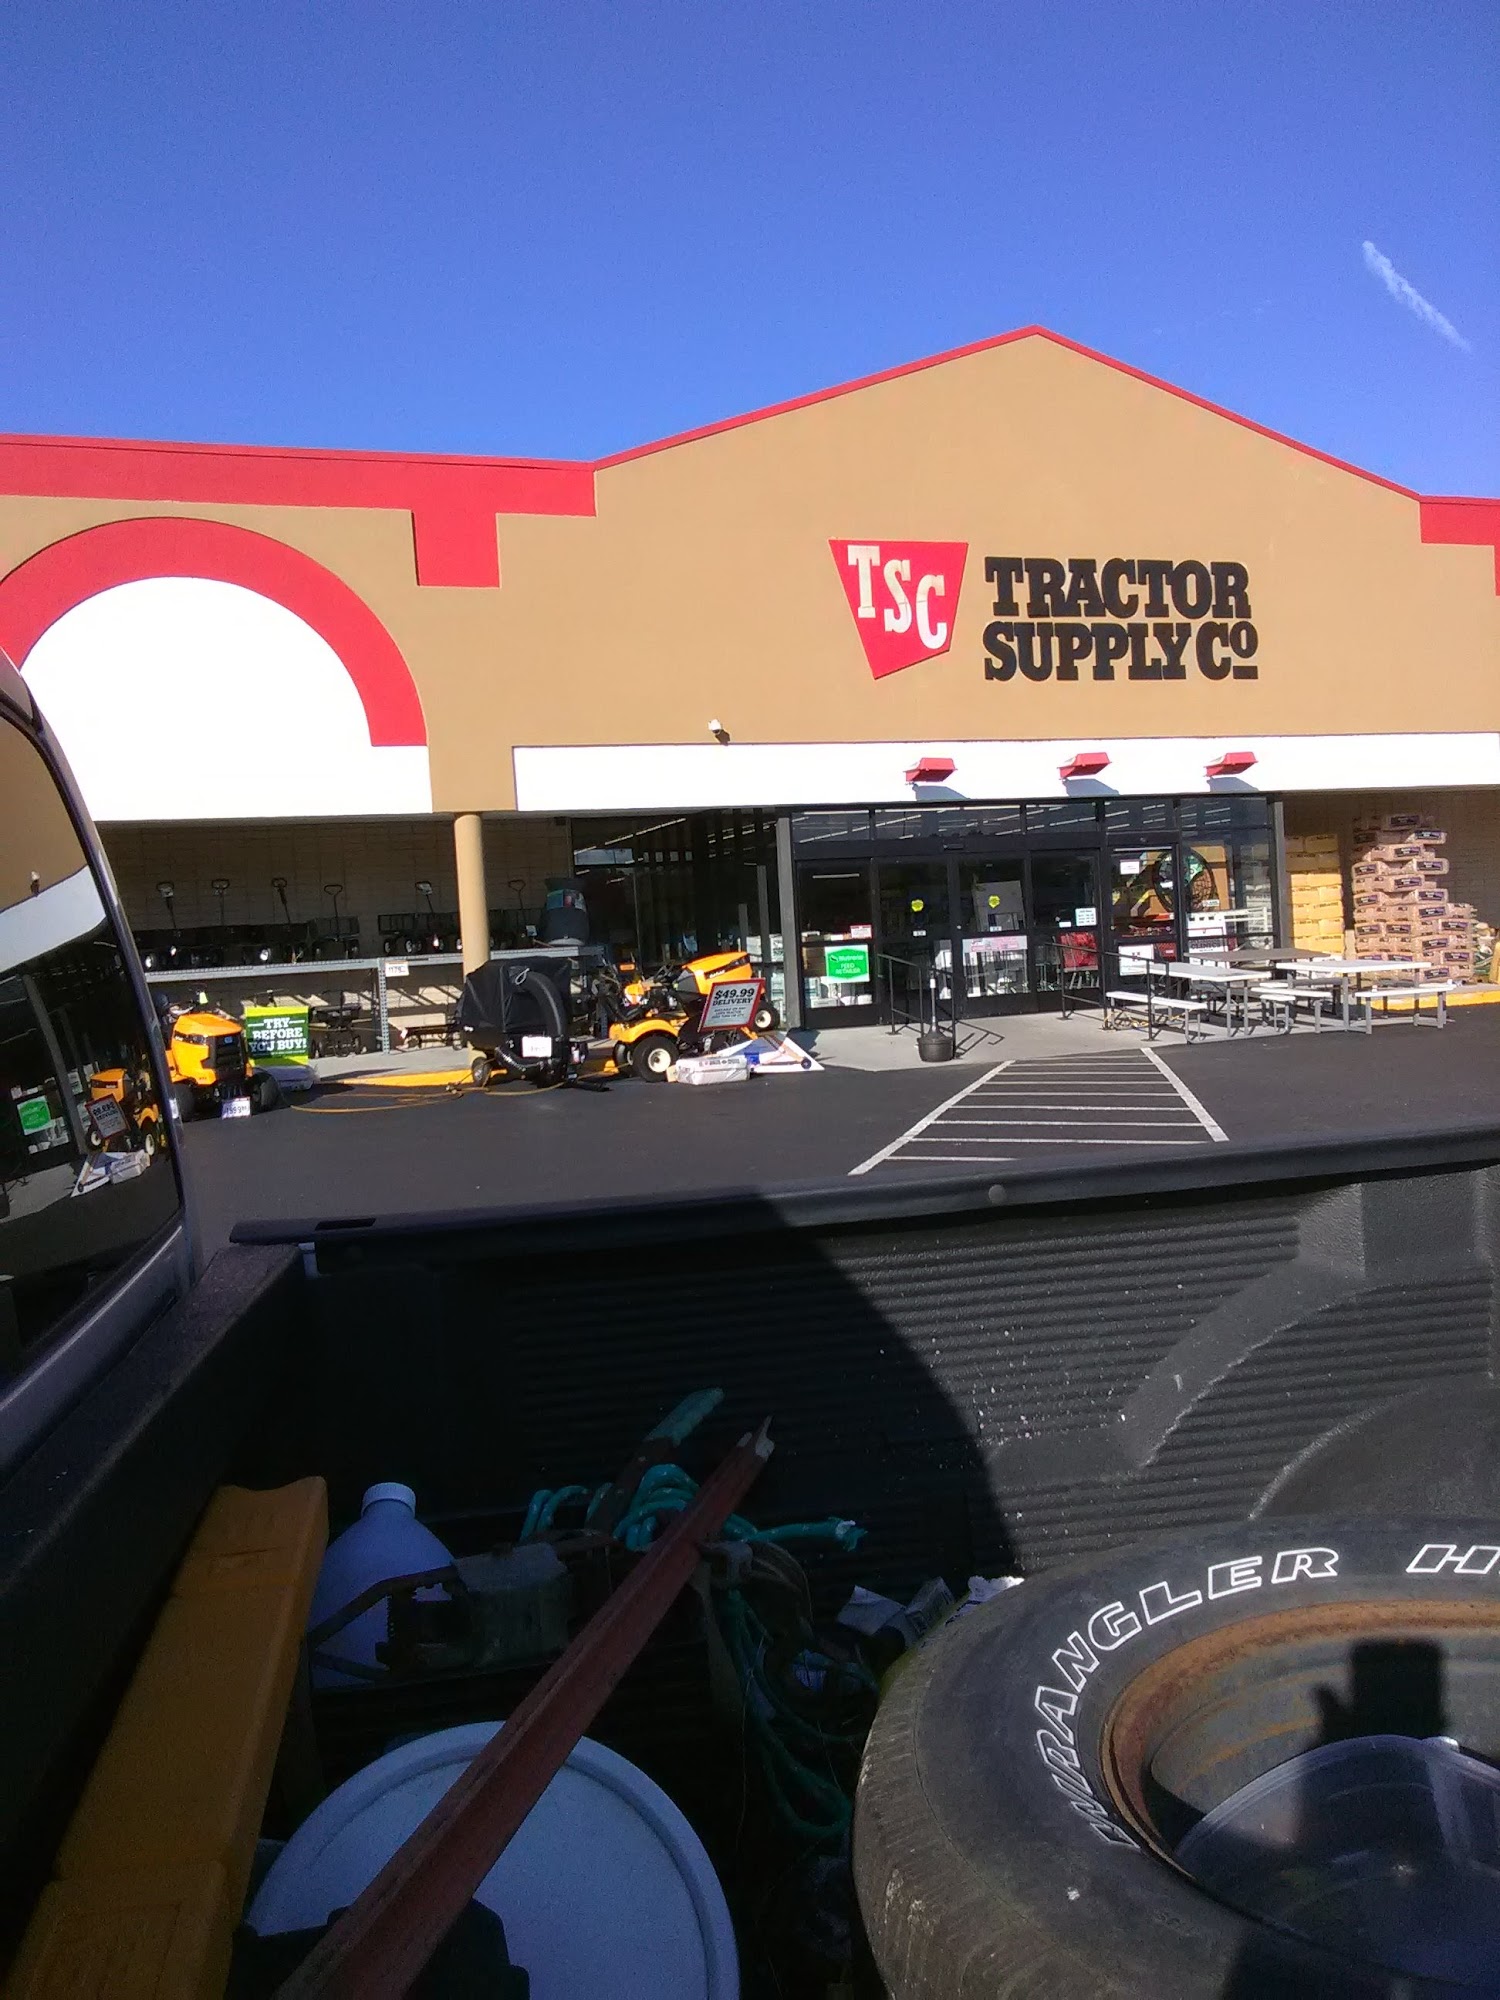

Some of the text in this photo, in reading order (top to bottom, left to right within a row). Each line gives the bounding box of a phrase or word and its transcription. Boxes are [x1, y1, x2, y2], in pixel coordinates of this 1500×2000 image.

[984, 556, 1252, 620] TRACTOR
[847, 545, 947, 650] TSC
[982, 620, 1192, 682] SUPPLY
[714, 988, 755, 1000] $49.99
[713, 998, 753, 1006] DELIVERY
[263, 1017, 290, 1029] TRY
[252, 1027, 303, 1040] BEFORE
[249, 1039, 307, 1052] YOU BUY!
[1035, 1543, 1500, 1850] WRANGLER H
